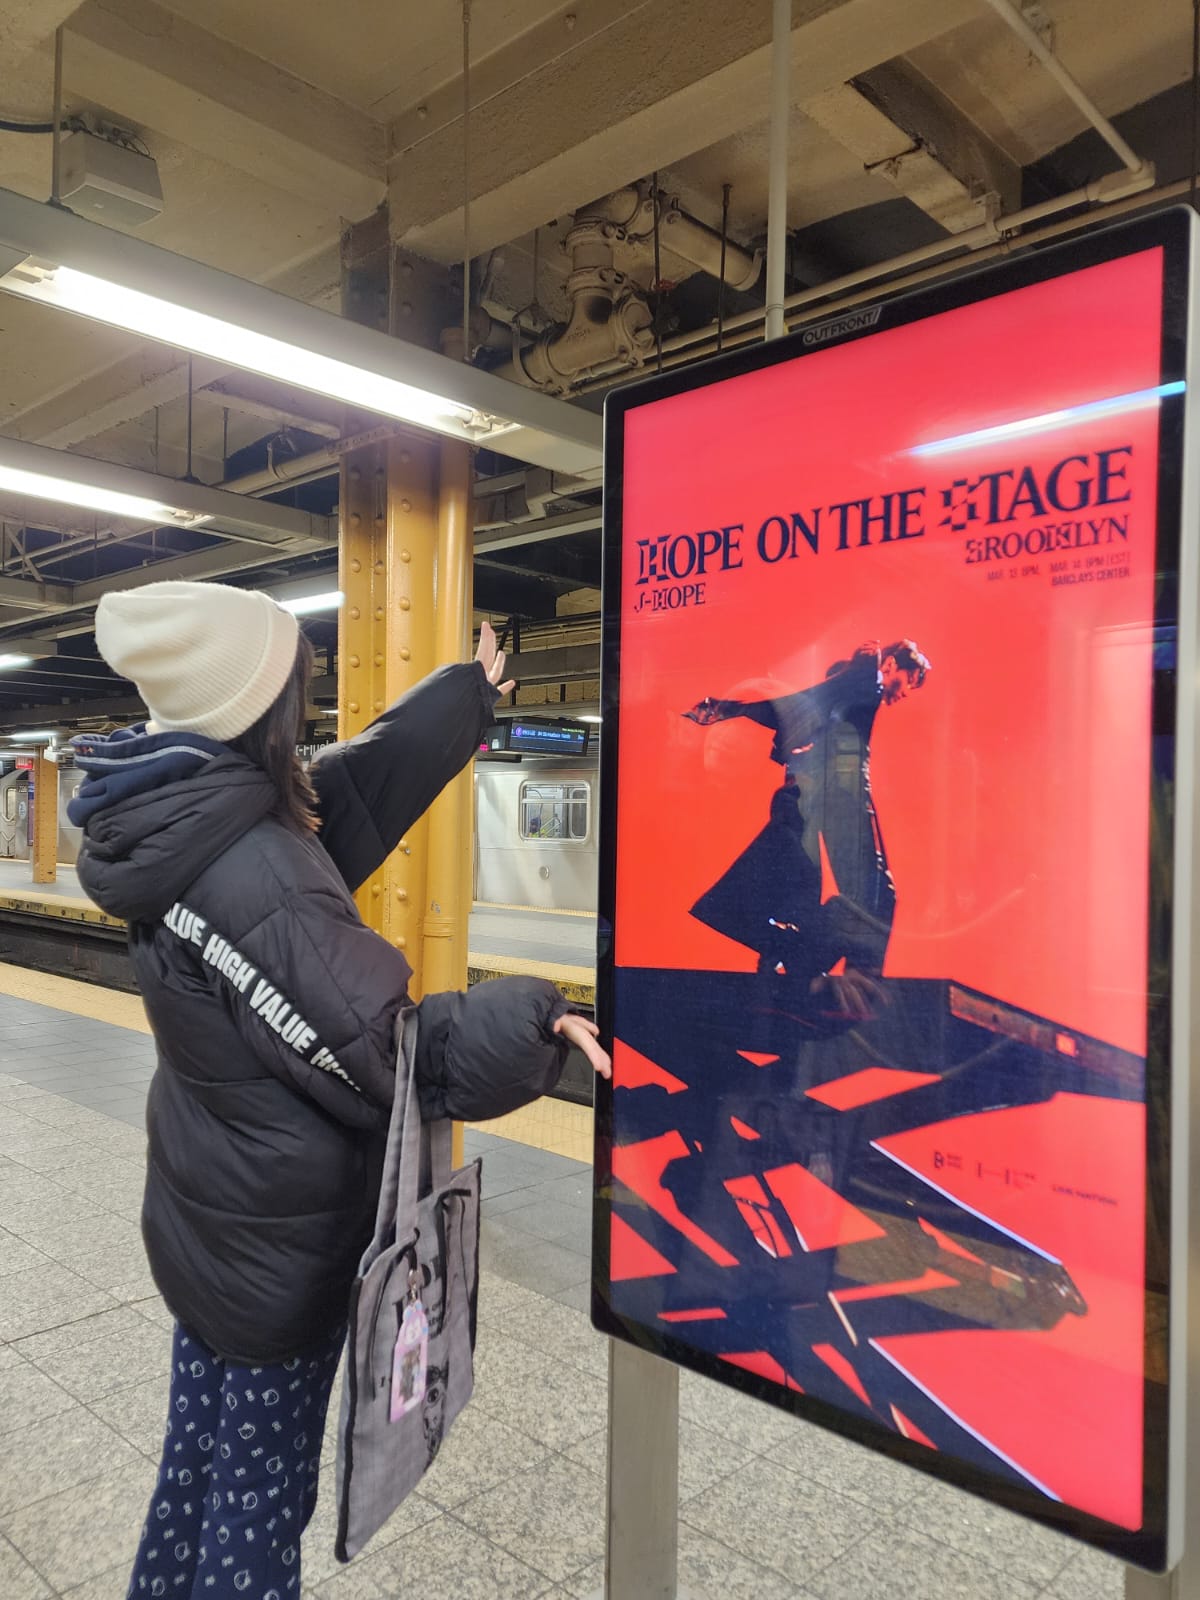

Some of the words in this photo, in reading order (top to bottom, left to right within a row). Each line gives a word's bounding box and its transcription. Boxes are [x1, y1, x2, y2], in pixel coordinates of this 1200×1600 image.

[635, 523, 744, 585] HOPE
[757, 507, 821, 564] ON
[829, 486, 926, 551] THE
[936, 445, 1134, 532] STAGE
[965, 514, 1129, 564] BROOKLYN
[633, 582, 706, 613] J-HOPE
[202, 933, 257, 994] HIGH
[249, 978, 318, 1054] VALUE
